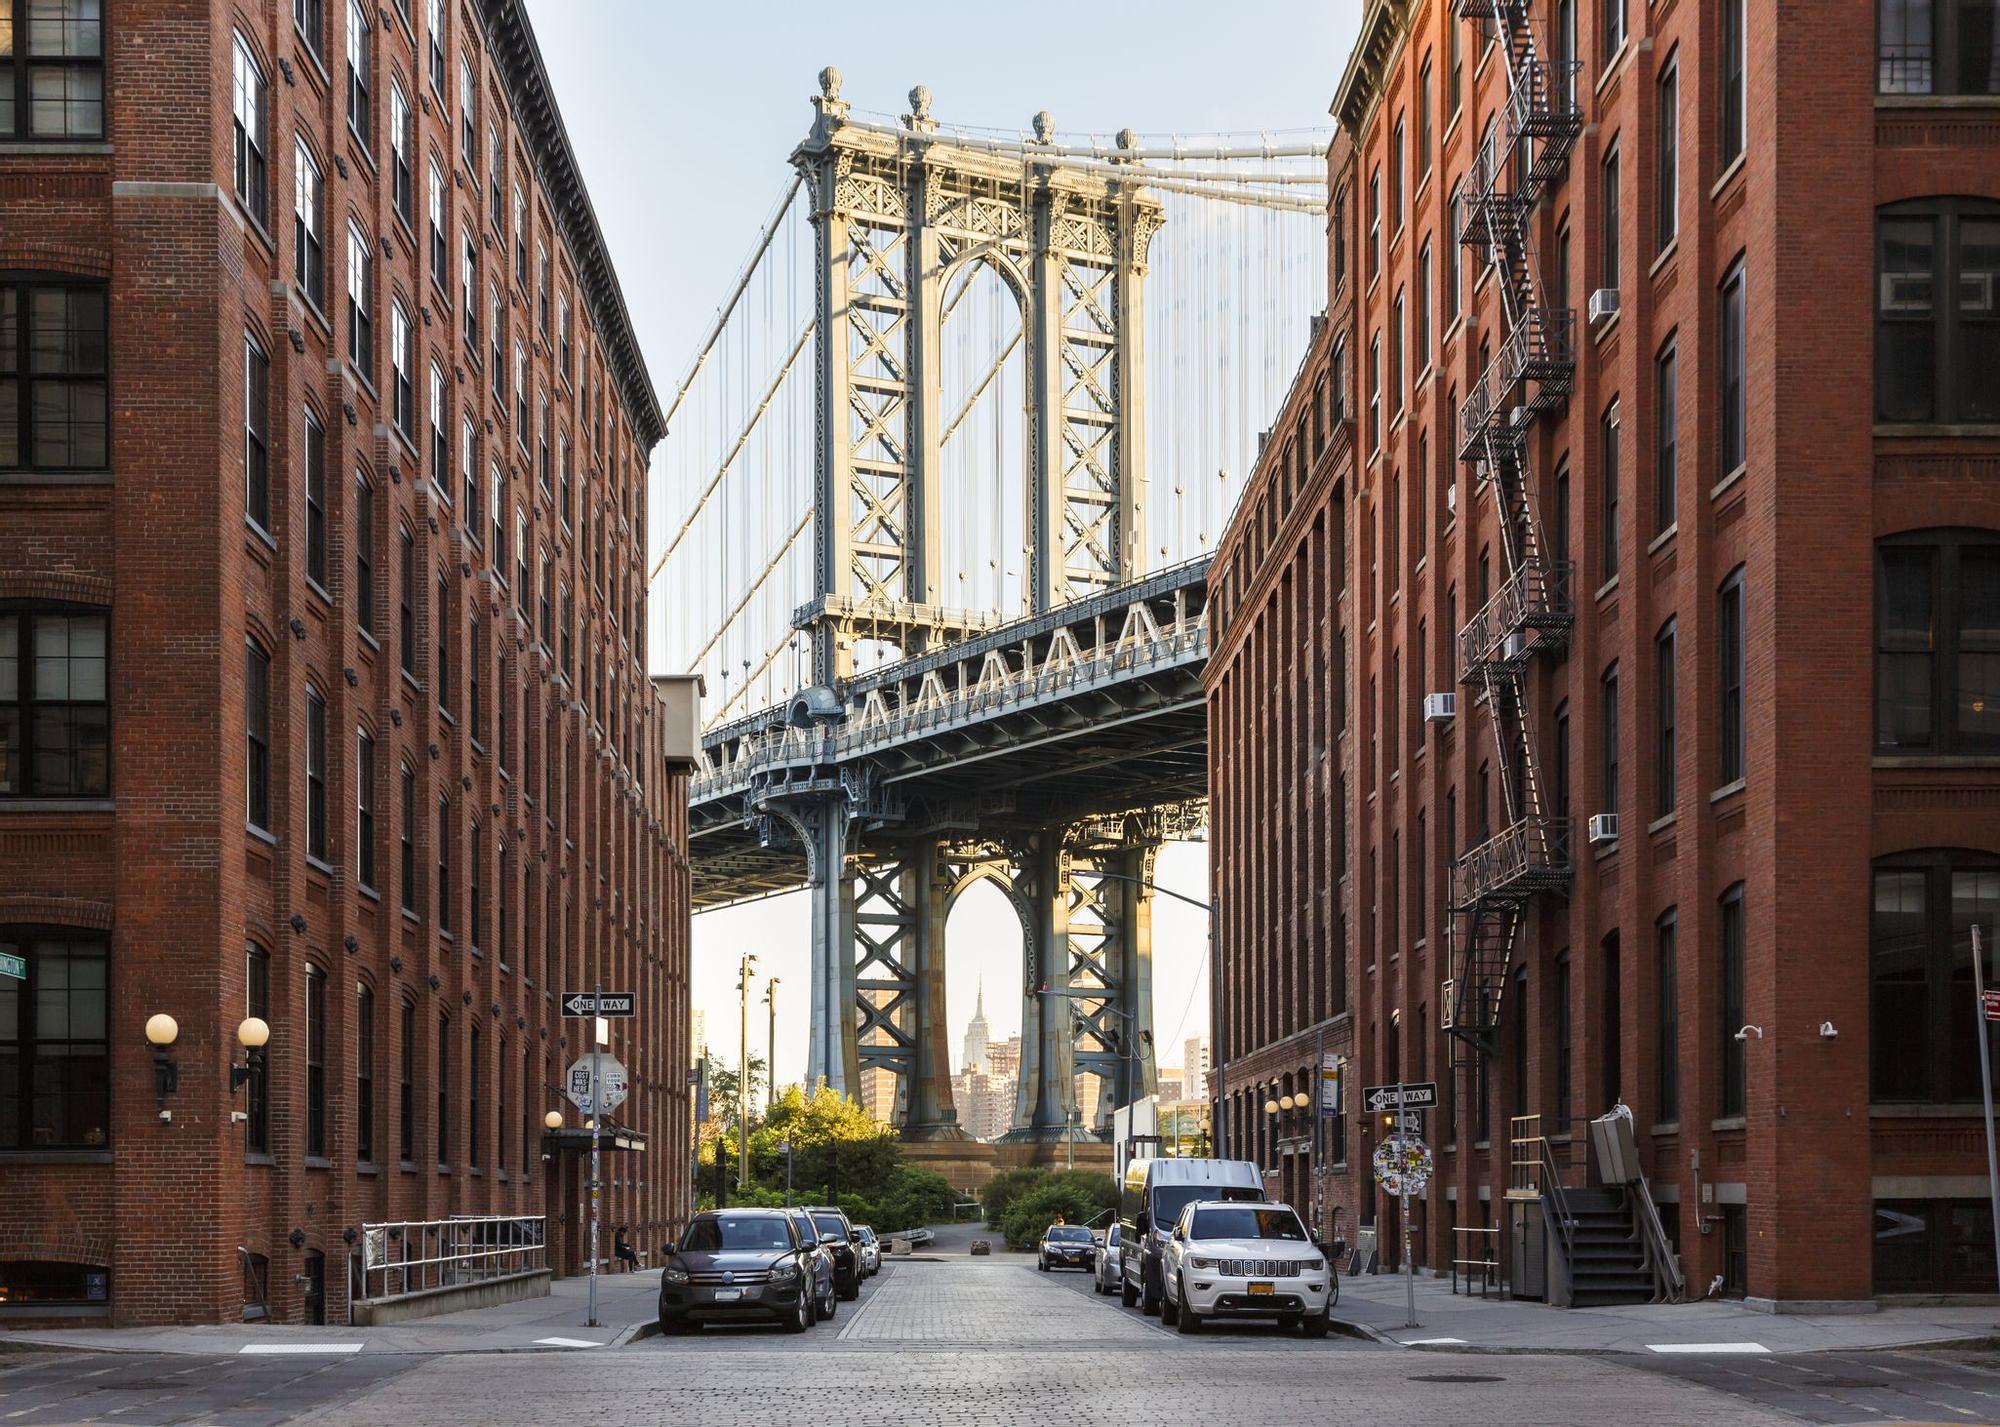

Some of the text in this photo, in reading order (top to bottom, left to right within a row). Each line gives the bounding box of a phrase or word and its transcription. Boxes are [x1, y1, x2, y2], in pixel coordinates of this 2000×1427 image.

[573, 1000, 625, 1010] ONE WAY
[574, 1071, 589, 1079] COST
[573, 1085, 588, 1093] HERE
[1375, 1091, 1427, 1104] ONE WAY
